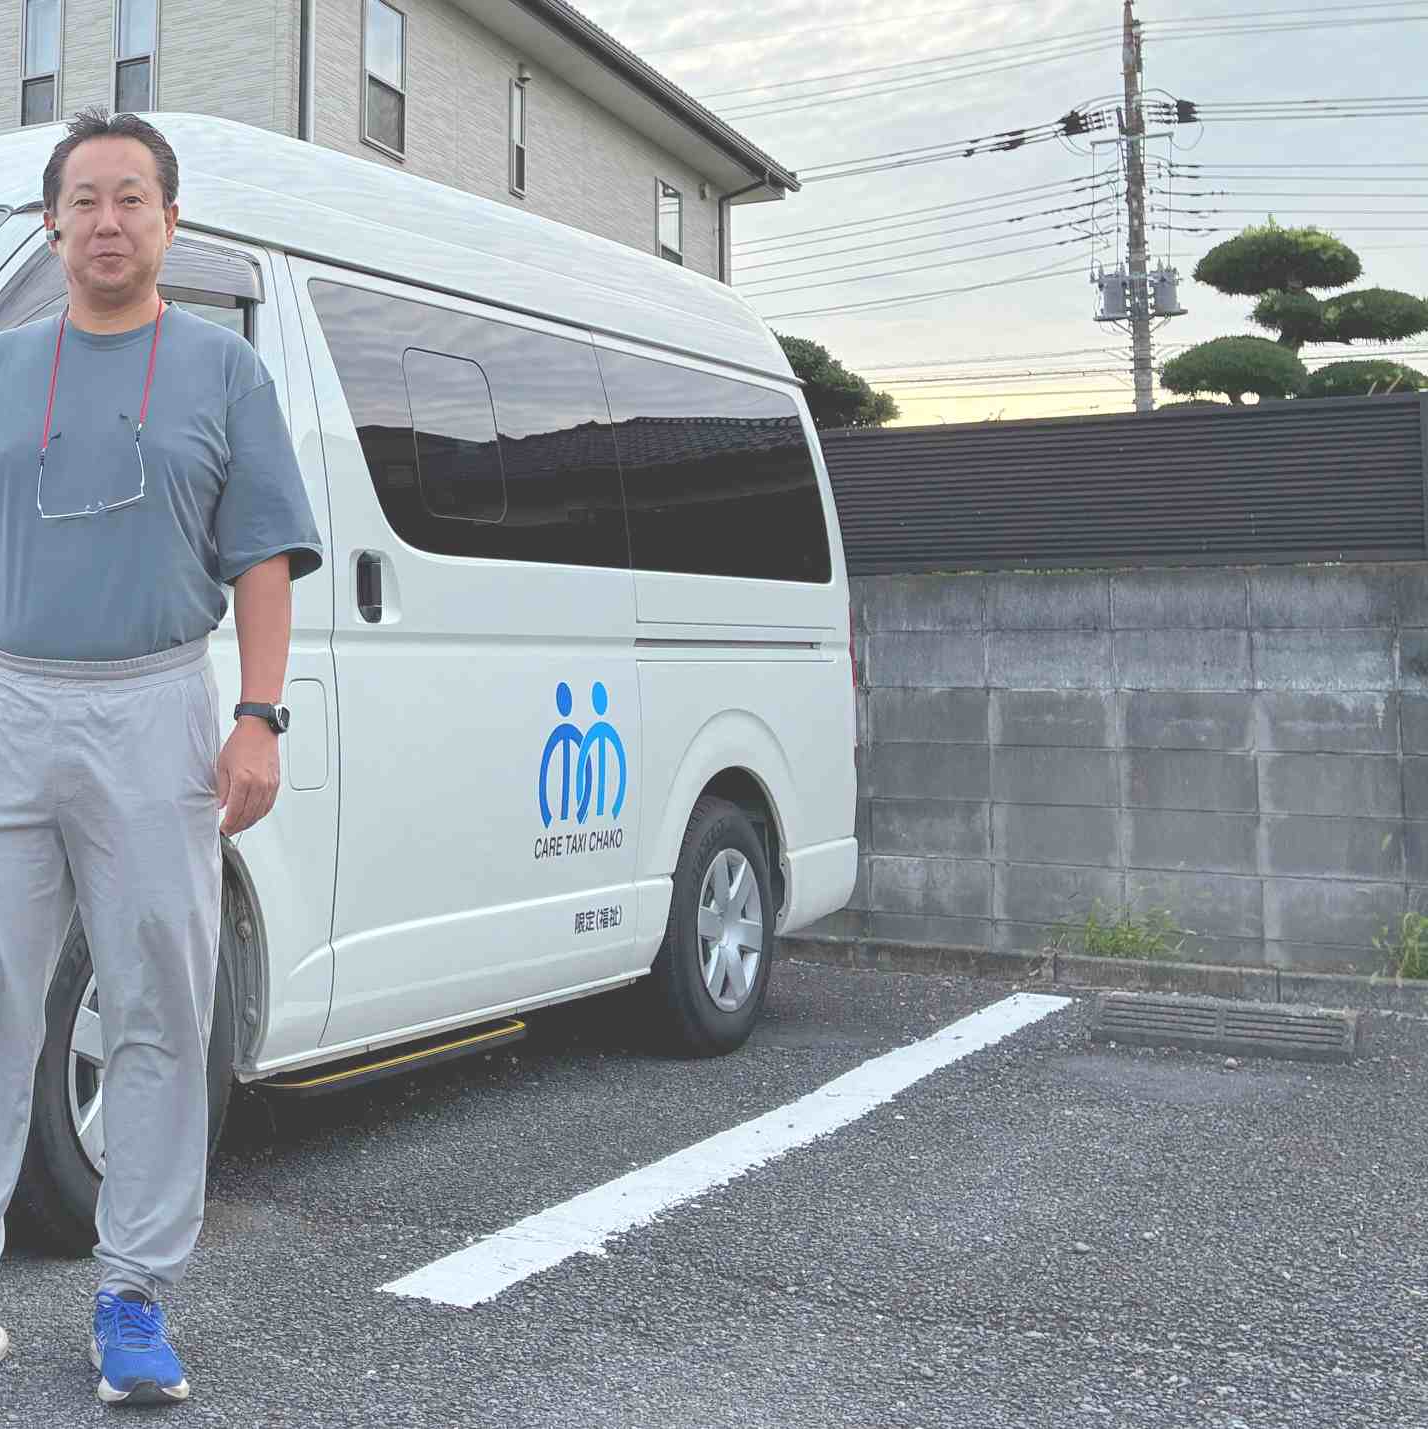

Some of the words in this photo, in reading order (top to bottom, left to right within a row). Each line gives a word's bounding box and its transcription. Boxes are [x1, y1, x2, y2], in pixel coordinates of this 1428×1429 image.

[534, 835, 563, 860] CARE
[566, 833, 587, 856] TAXI
[589, 828, 623, 852] CHAKO
